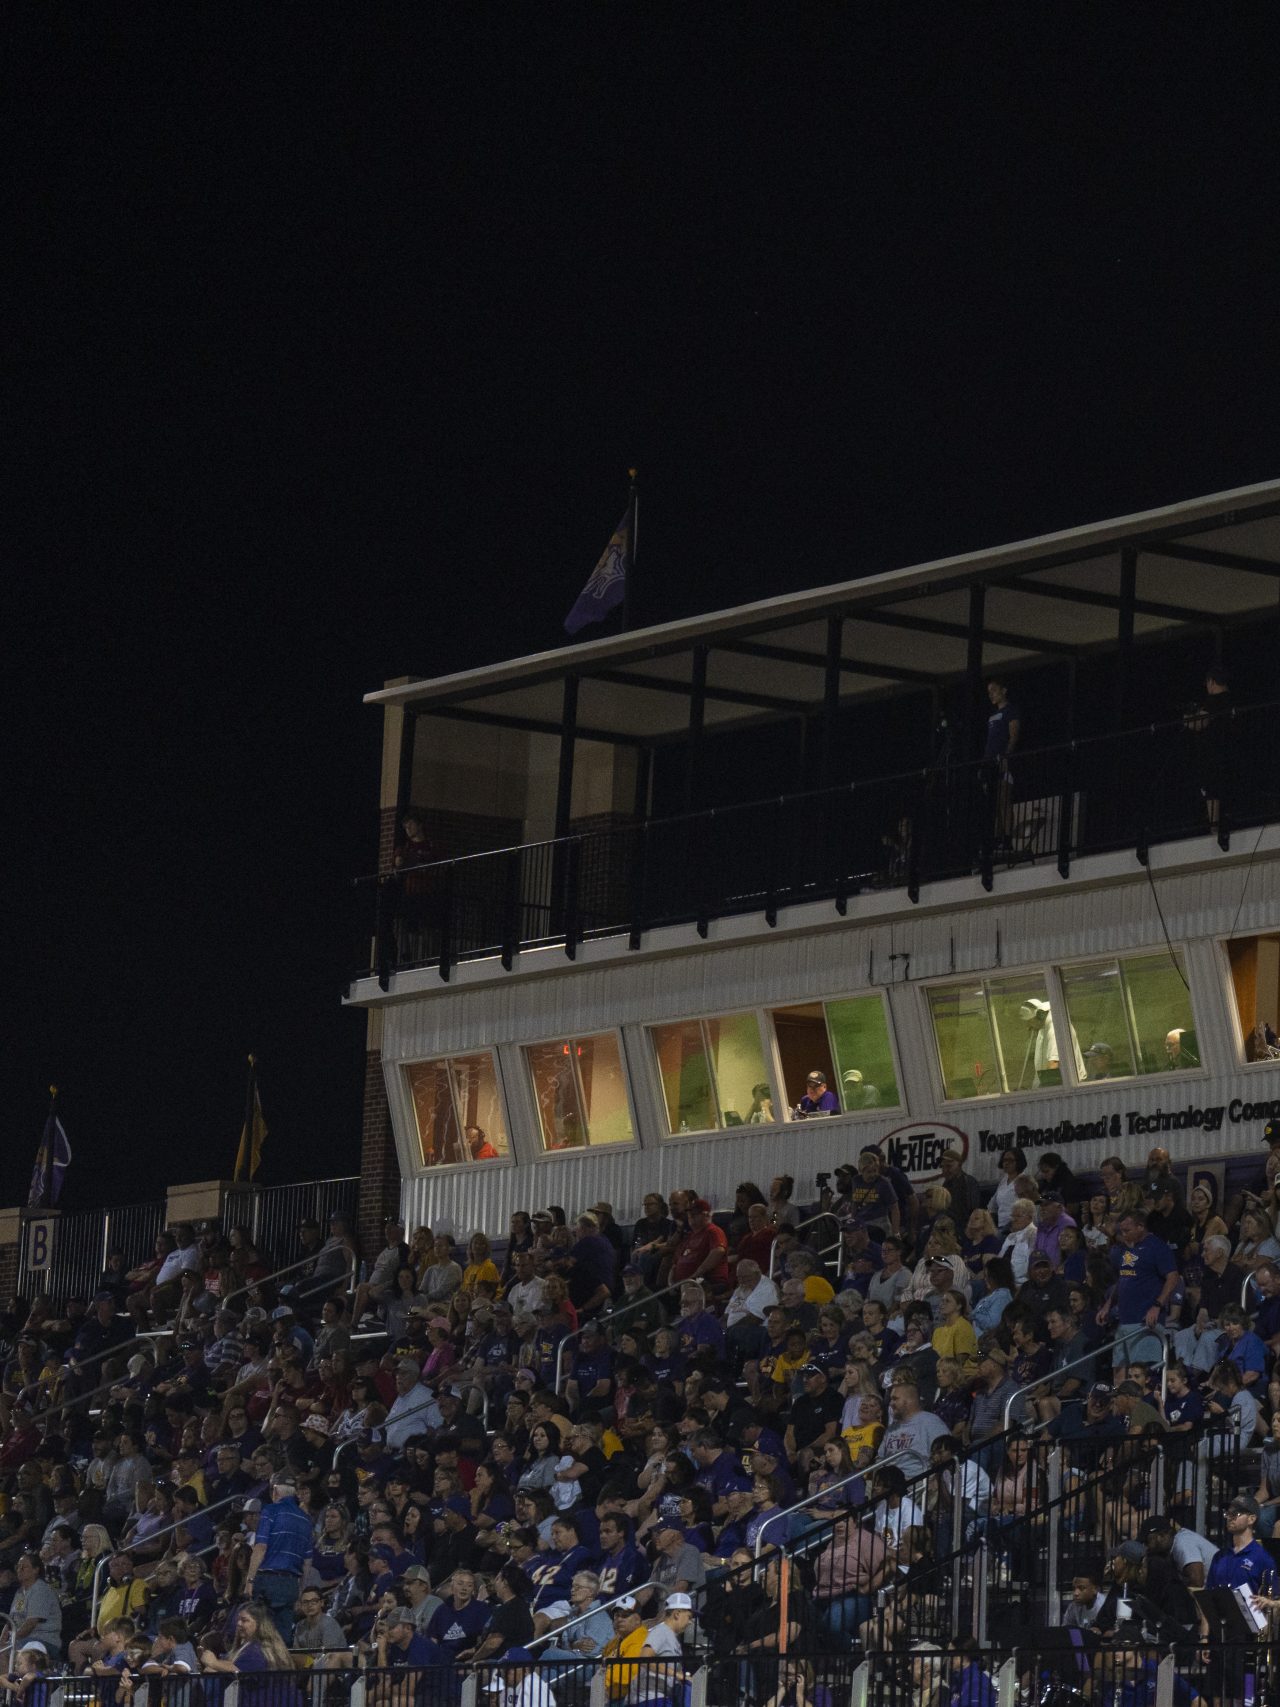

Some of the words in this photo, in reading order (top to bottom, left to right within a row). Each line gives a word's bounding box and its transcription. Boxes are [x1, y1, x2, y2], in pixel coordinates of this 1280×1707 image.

[979, 1130, 1014, 1153] Your
[1017, 1116, 1107, 1149] Broadband
[1109, 1114, 1122, 1137] &
[1126, 1105, 1224, 1134] Technology
[32, 1225, 47, 1266] B
